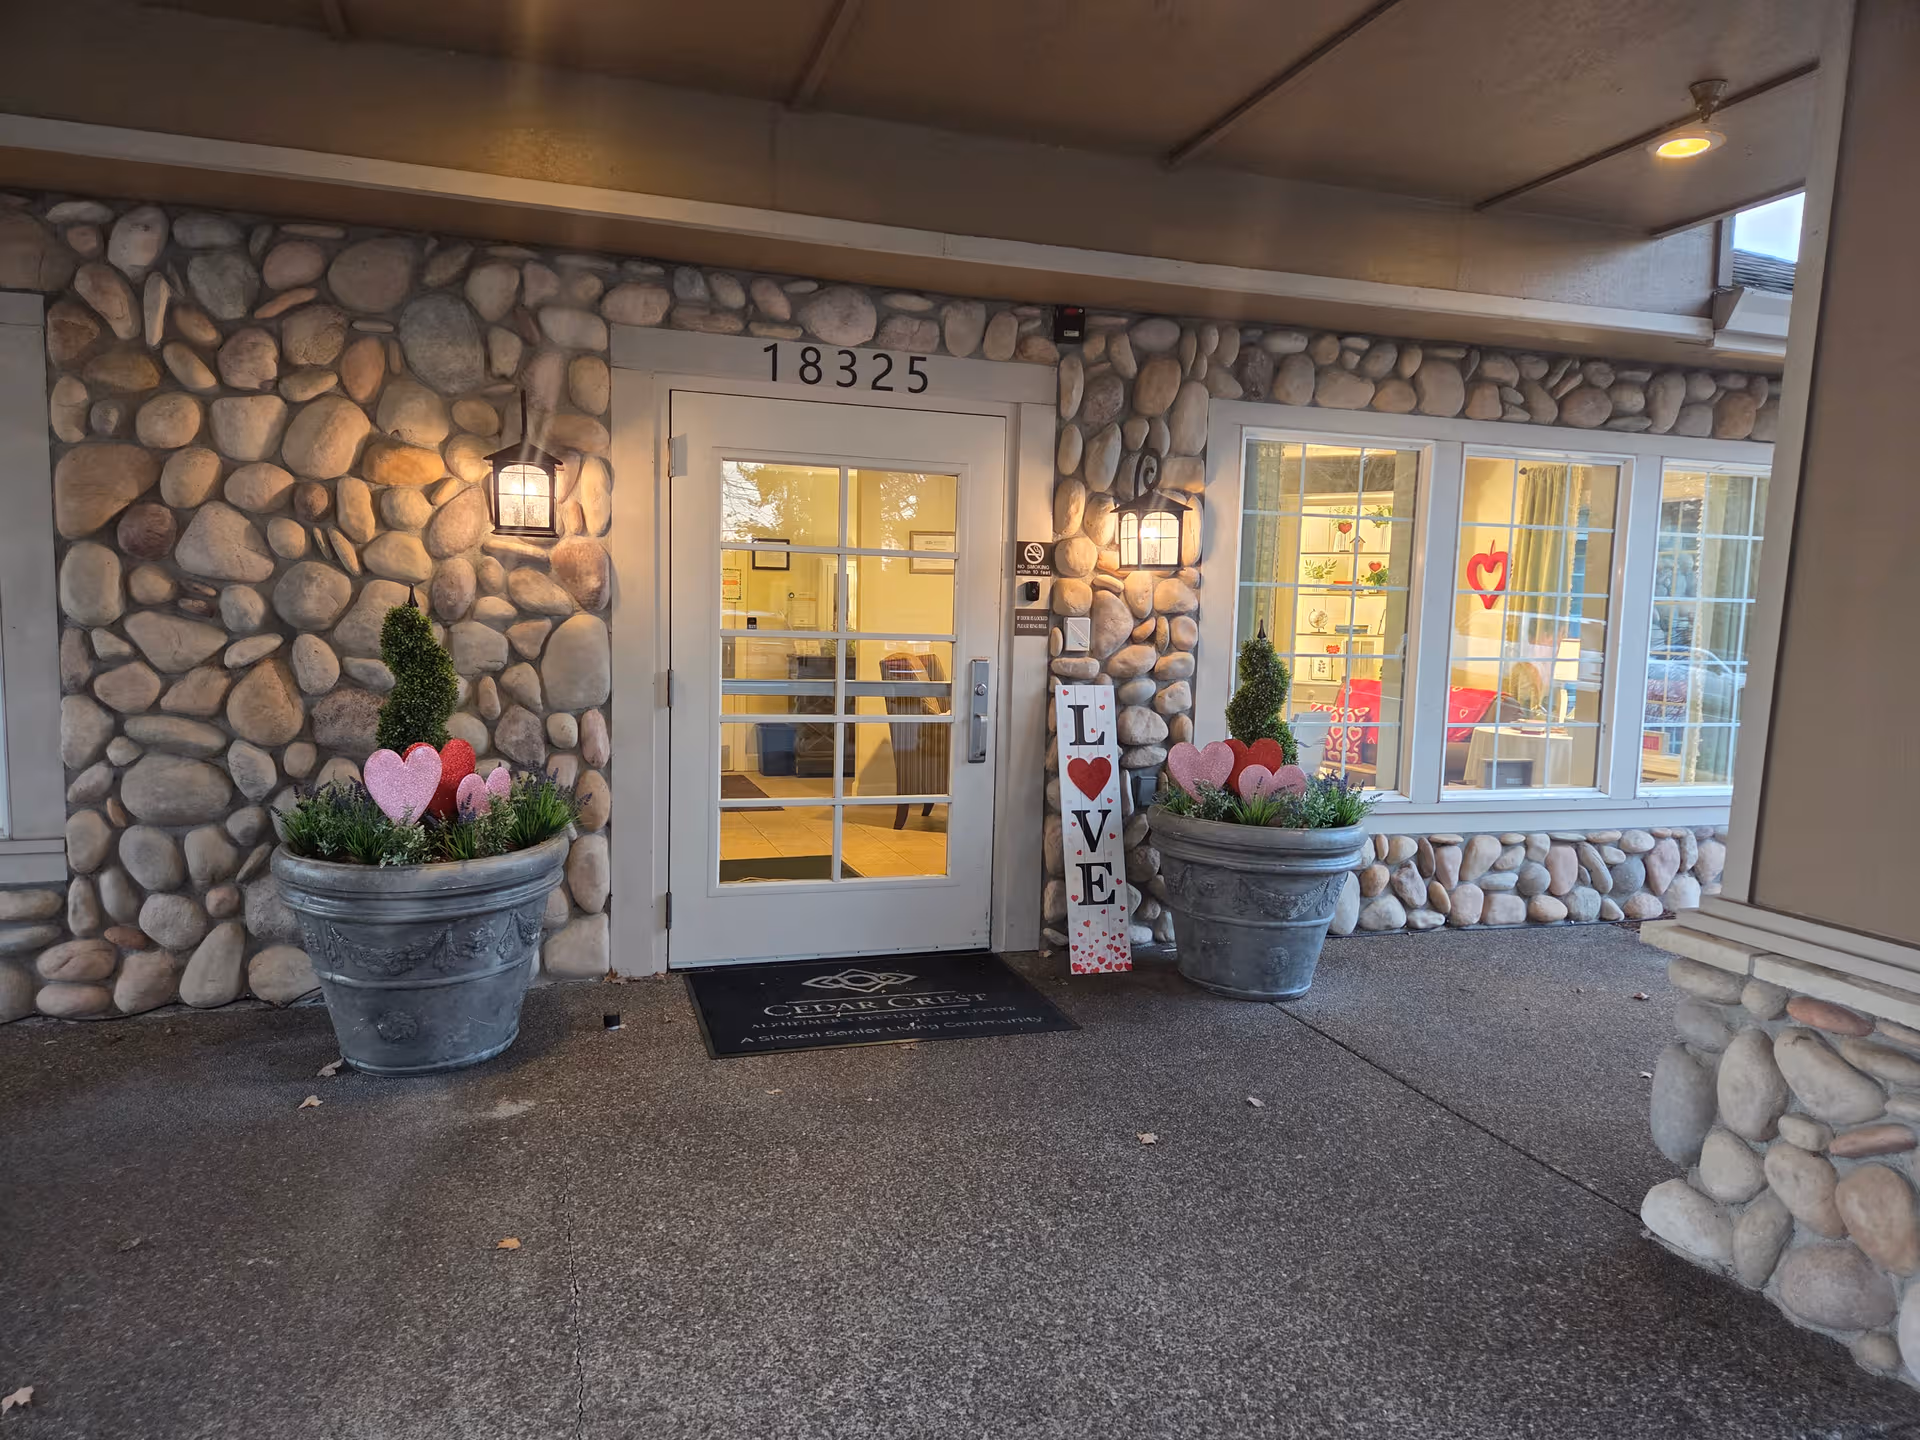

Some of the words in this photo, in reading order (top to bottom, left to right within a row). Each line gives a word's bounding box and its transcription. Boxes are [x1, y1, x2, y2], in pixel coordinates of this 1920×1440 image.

[763, 343, 928, 393] 18325
[1067, 705, 1116, 906] LVE
[763, 1001, 881, 1017] CEDAR
[887, 992, 988, 1008] CREST
[825, 1028, 882, 1037] Senior
[886, 1021, 940, 1034] Living
[943, 1015, 1043, 1029] Community
